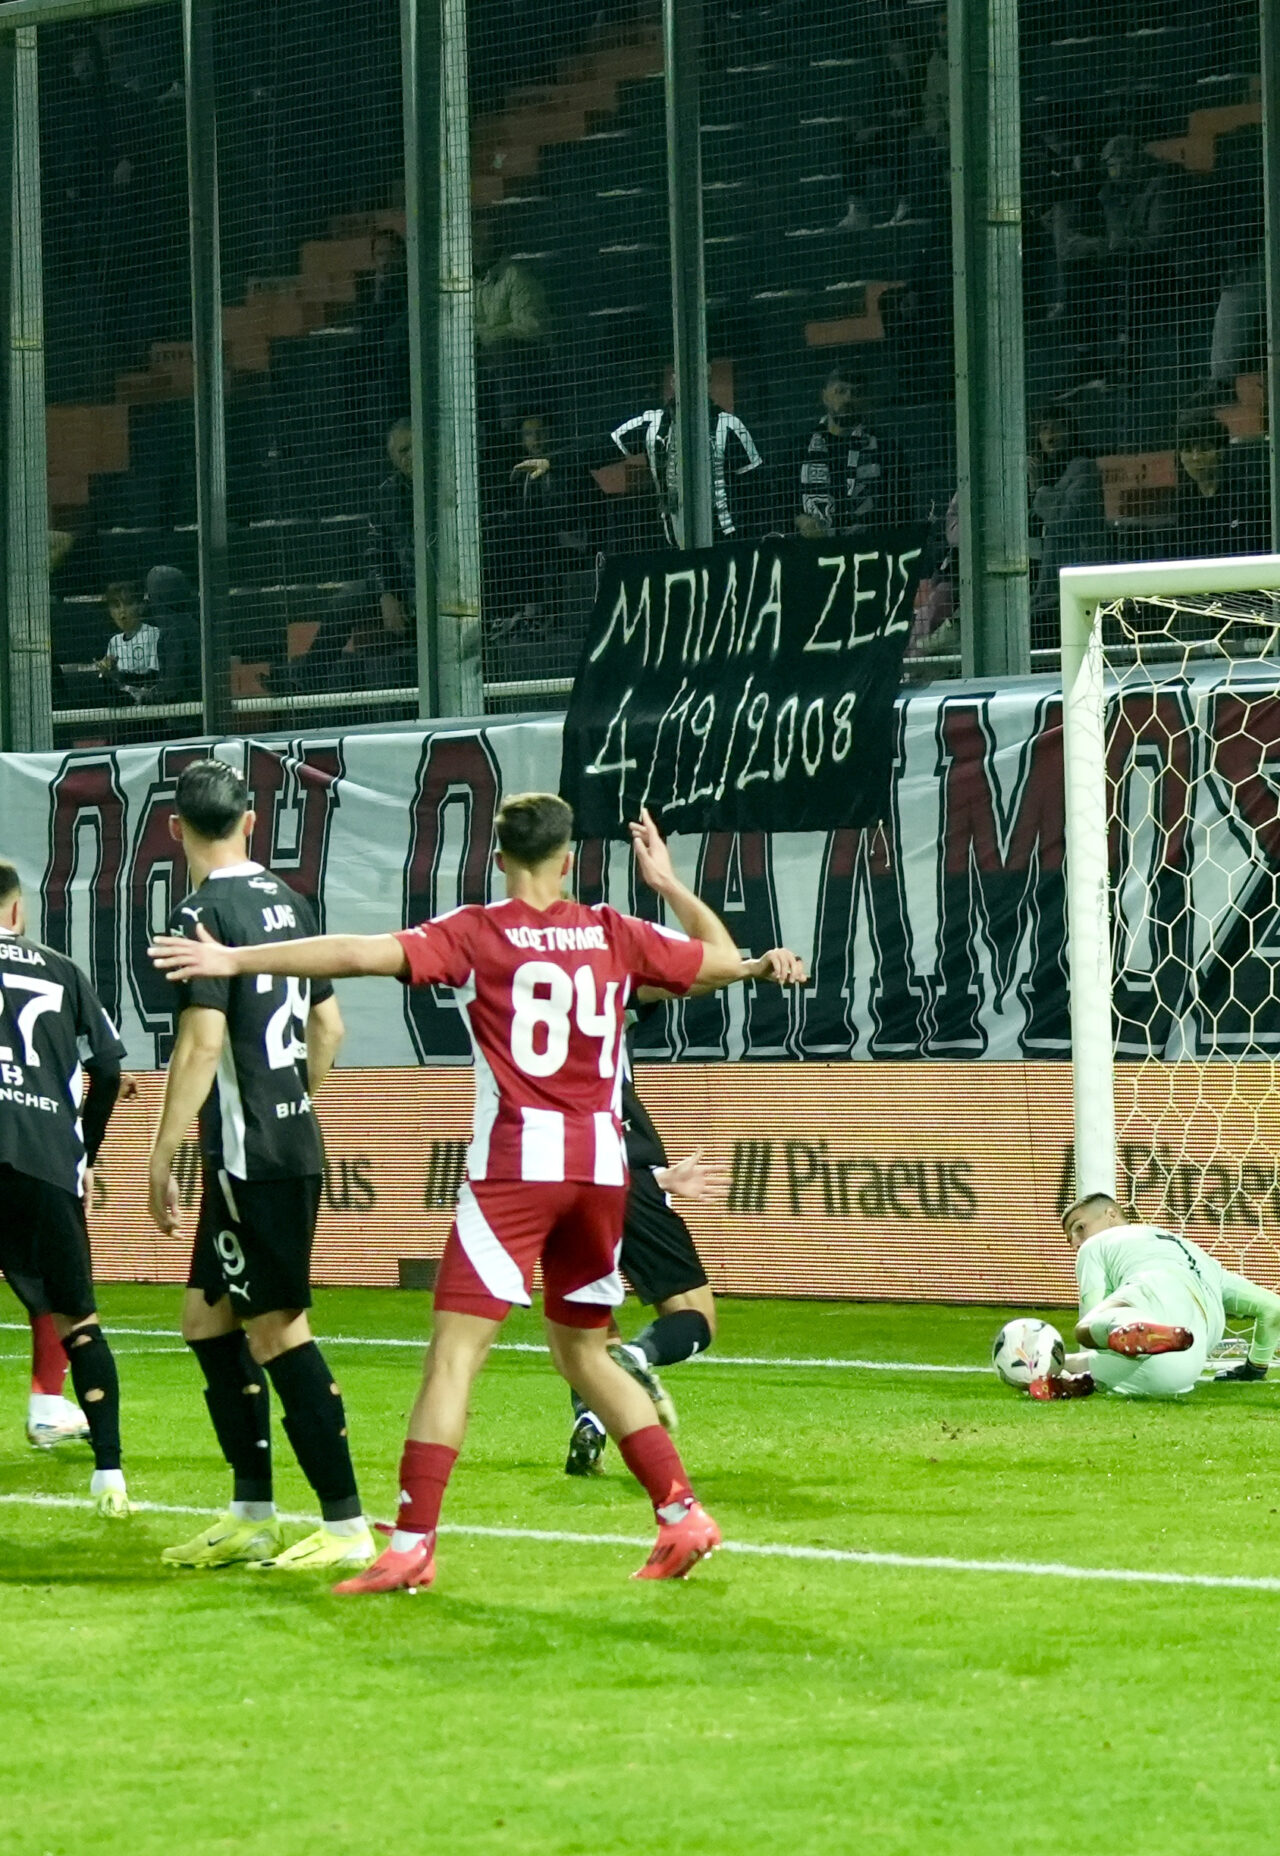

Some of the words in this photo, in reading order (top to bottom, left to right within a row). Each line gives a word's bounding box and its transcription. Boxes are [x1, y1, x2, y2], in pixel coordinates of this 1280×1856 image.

[0, 972, 64, 1067] 7
[511, 961, 619, 1078] 84
[784, 1138, 977, 1220] Piraeus
